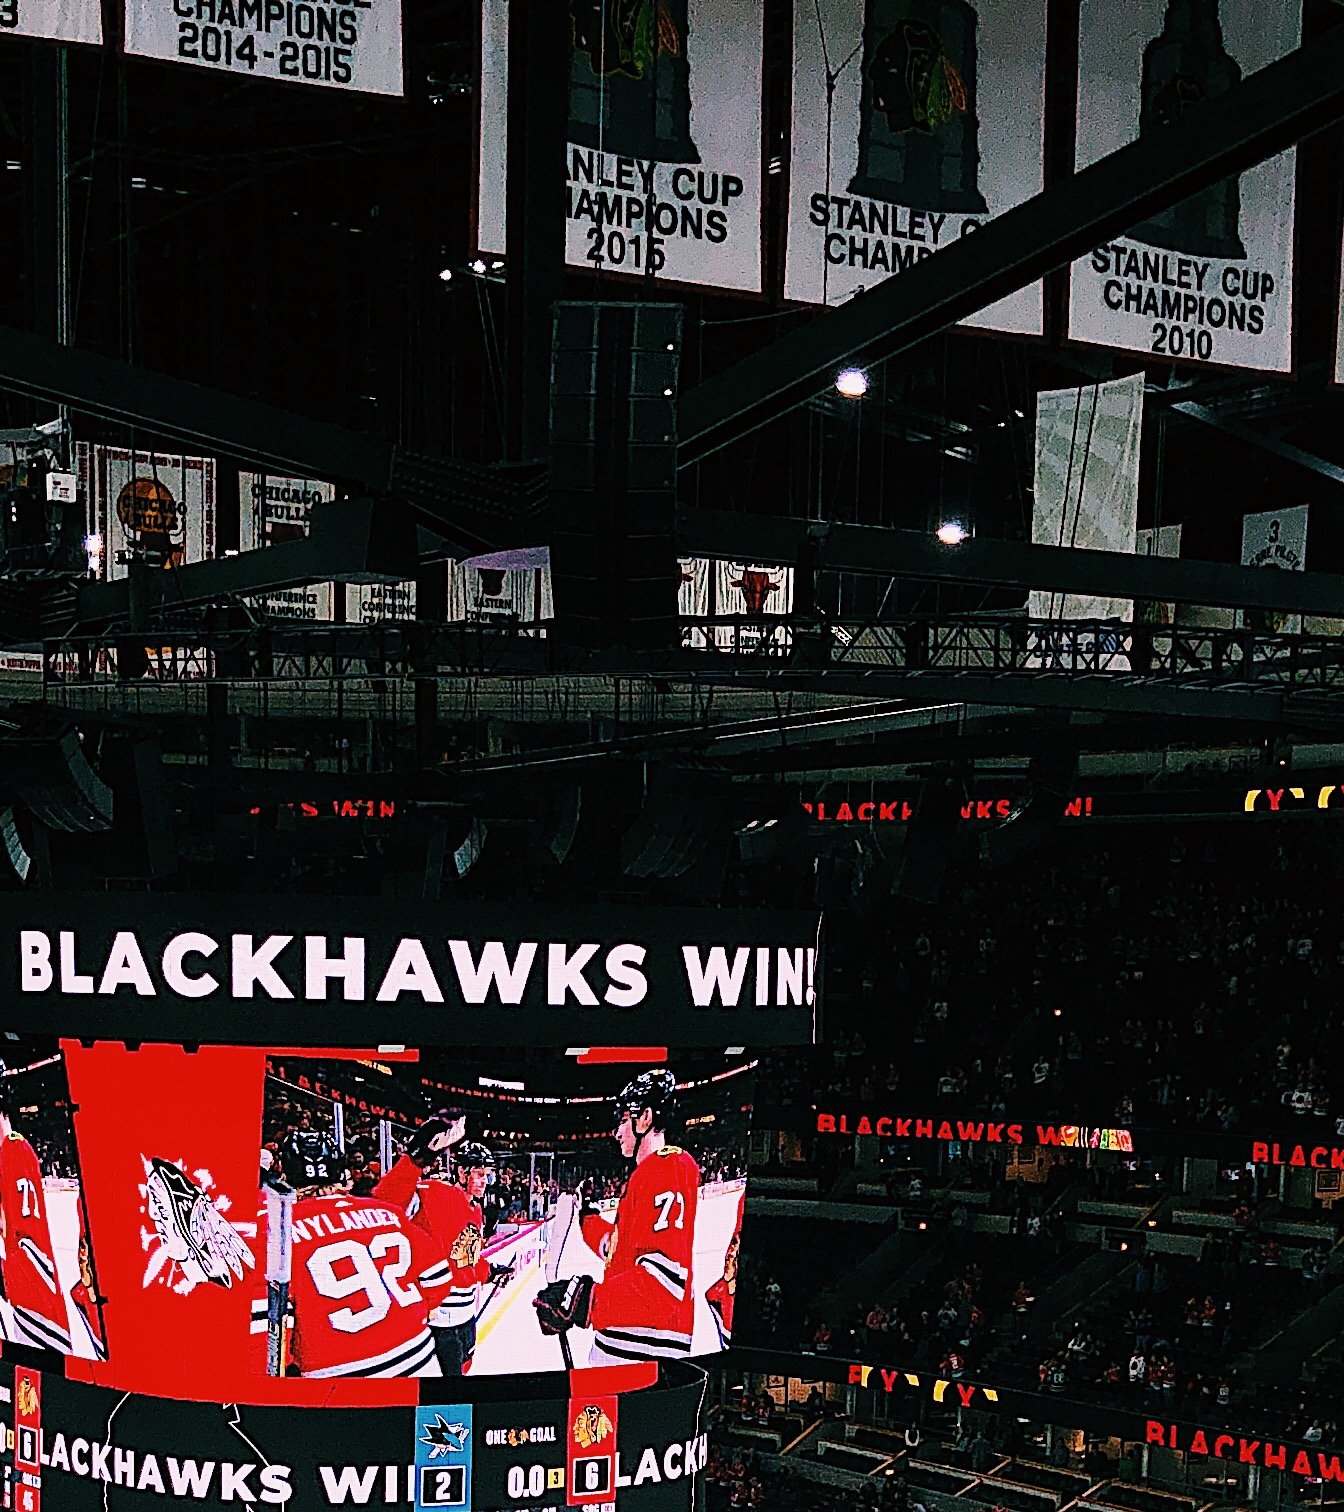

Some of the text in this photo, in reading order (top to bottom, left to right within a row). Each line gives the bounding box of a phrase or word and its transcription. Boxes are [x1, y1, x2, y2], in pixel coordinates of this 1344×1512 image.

[179, 23, 352, 83] 2014-2015
[672, 168, 743, 206] CUP
[809, 197, 946, 244] STANLEY
[1091, 245, 1275, 303] STANLEY CUP
[1103, 280, 1265, 335] CHAMPIONS
[1151, 323, 1213, 360] 2010
[251, 484, 322, 503] CHICAGO
[21, 930, 815, 1007] BLACKHAWKS WIN!
[818, 1113, 1026, 1144] BLACKHAWKS
[306, 1164, 328, 1177] 92
[306, 1231, 423, 1333] 92
[486, 1427, 556, 1446] ONE GOAL
[40, 1428, 292, 1503] LACKHAWKS
[508, 1465, 544, 1498] 0.0
[553, 1471, 560, 1485] 3
[585, 1462, 599, 1490] 6
[436, 1472, 451, 1501] 2
